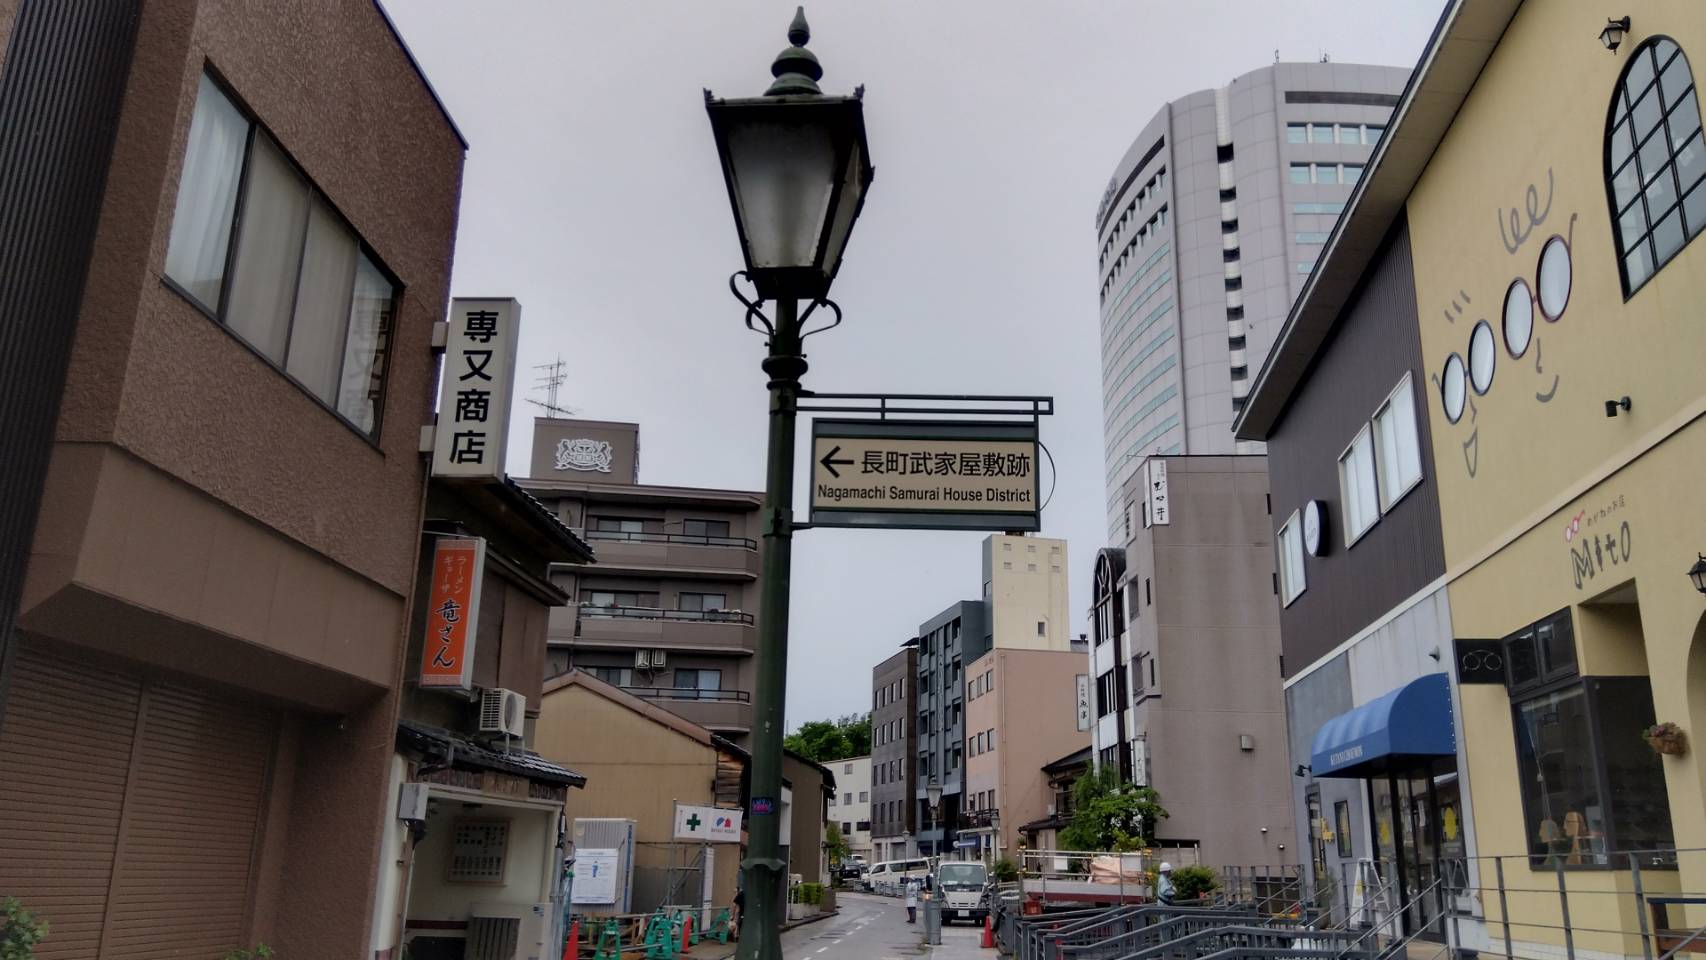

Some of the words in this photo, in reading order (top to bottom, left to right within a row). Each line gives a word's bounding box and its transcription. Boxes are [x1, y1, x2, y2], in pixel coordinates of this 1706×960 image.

[449, 310, 499, 465] 専又商店
[861, 450, 1031, 477] 長町武家屋敷跡
[818, 484, 886, 502] Nagamachi
[889, 486, 940, 501] Samurai
[943, 487, 983, 502] House
[986, 488, 1031, 502] District
[454, 555, 467, 594] ラーメン
[432, 598, 461, 669] 竜さん
